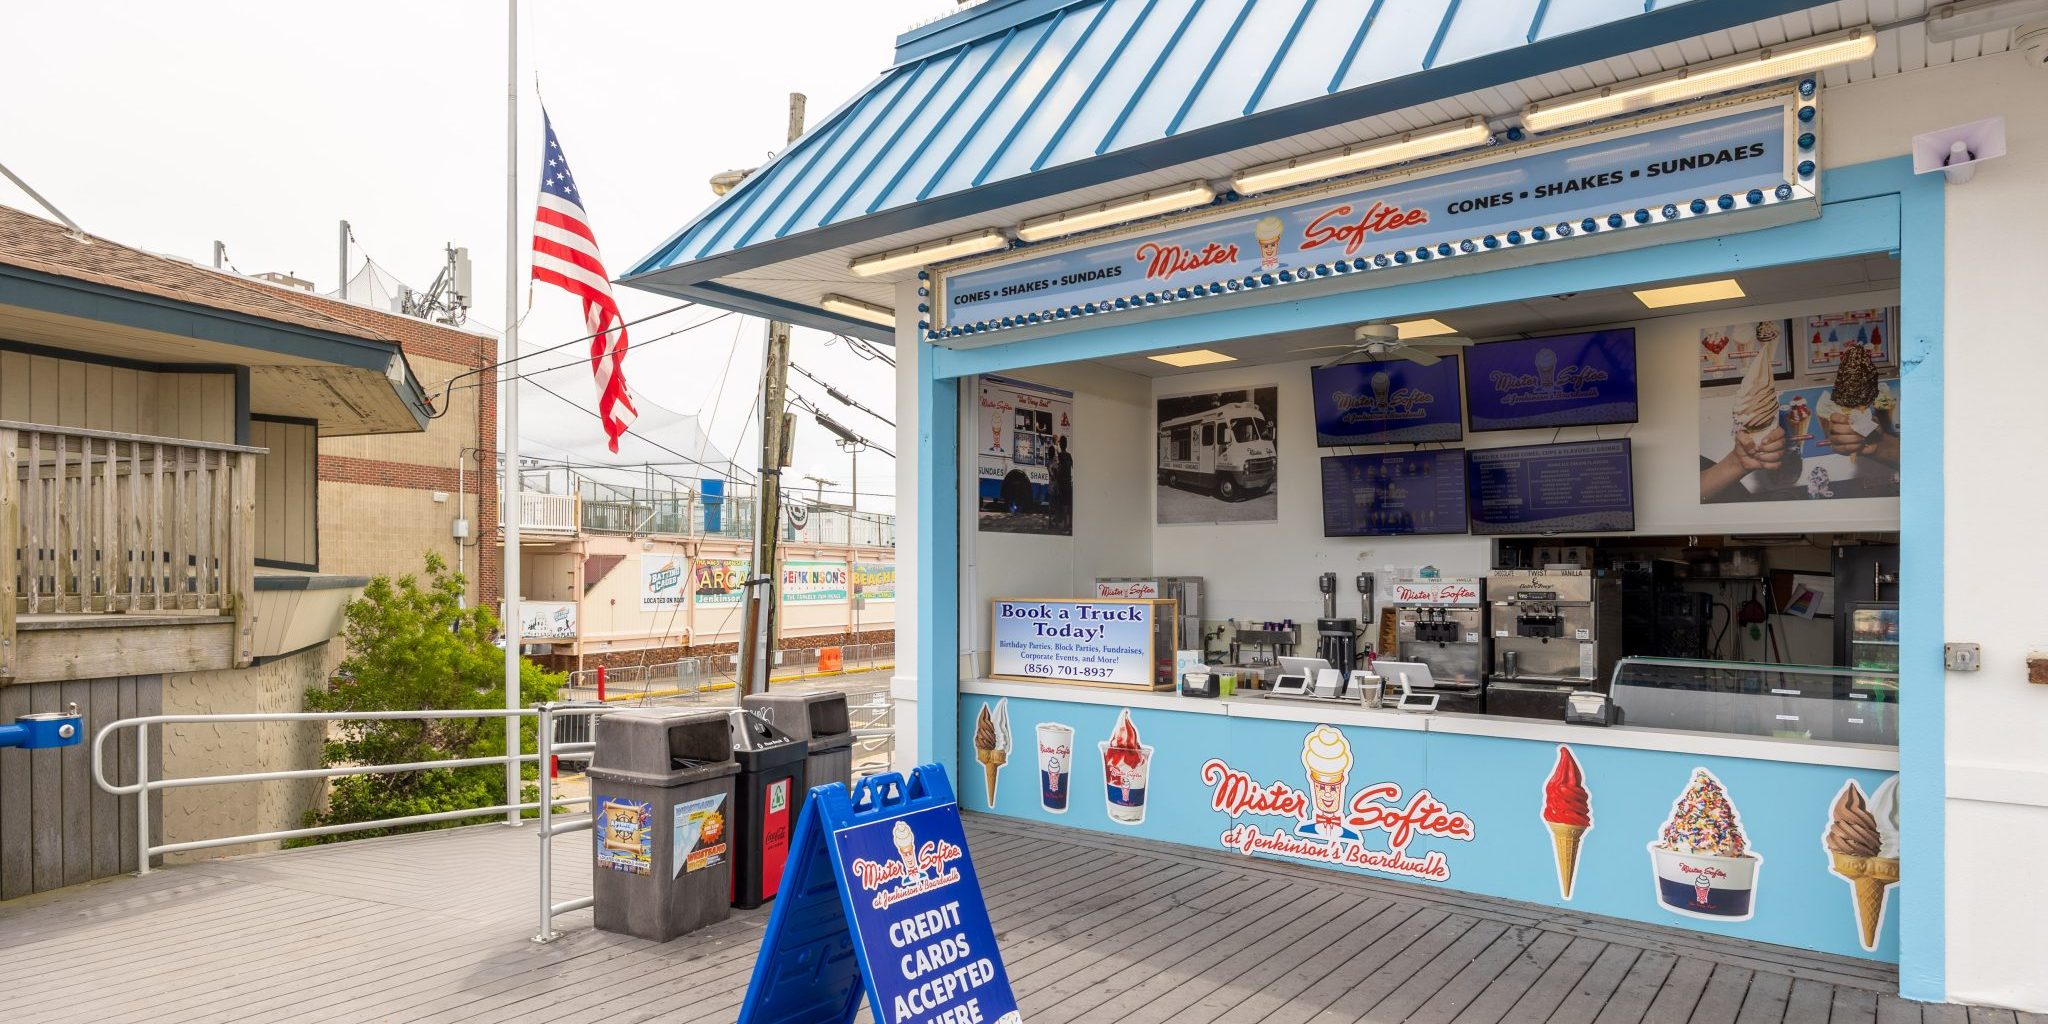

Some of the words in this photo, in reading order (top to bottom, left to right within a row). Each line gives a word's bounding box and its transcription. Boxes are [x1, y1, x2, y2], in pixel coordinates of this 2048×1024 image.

[1447, 190, 1513, 215] CONES
[1534, 170, 1624, 198] SHAKES
[1646, 142, 1765, 178] SUNDAES
[1136, 243, 1239, 280] Mister
[1300, 202, 1426, 254] Softee
[954, 290, 991, 306] CONES
[1001, 279, 1049, 297] SHAKES
[1061, 266, 1122, 287] SUNDAES
[1099, 584, 1123, 596] Mister
[1130, 583, 1155, 598] Softee
[1397, 586, 1430, 601] Mister
[1440, 585, 1475, 603] Softee
[1001, 604, 1052, 619] Book
[1059, 608, 1069, 619] a
[1076, 605, 1142, 622] Truck
[1033, 622, 1105, 642] Today!
[1000, 640, 1027, 650] Birthday
[1029, 642, 1053, 651] Parties,
[1055, 643, 1073, 652] Block
[1075, 644, 1101, 653] Parties,
[1021, 652, 1053, 662] Corporate
[1055, 653, 1081, 662] Events,
[1082, 655, 1095, 663] and
[1097, 655, 1119, 664] More!
[1024, 664, 1053, 675] (856)
[1058, 665, 1114, 678] 701-8937
[1205, 763, 1304, 818] Mister
[1350, 787, 1469, 848] Softee
[855, 861, 903, 888] Mister
[920, 842, 960, 874] Softee
[1224, 828, 1241, 844] at
[1244, 829, 1340, 858] Jenkinson's
[1346, 845, 1446, 877] Boardwalk
[874, 897, 882, 907] at
[884, 883, 923, 907] Jenkinson's
[924, 869, 959, 889] Boardwalk
[889, 901, 960, 948] CREDIT
[901, 933, 970, 980] CARDS
[894, 958, 995, 1024] ACCEPTED
